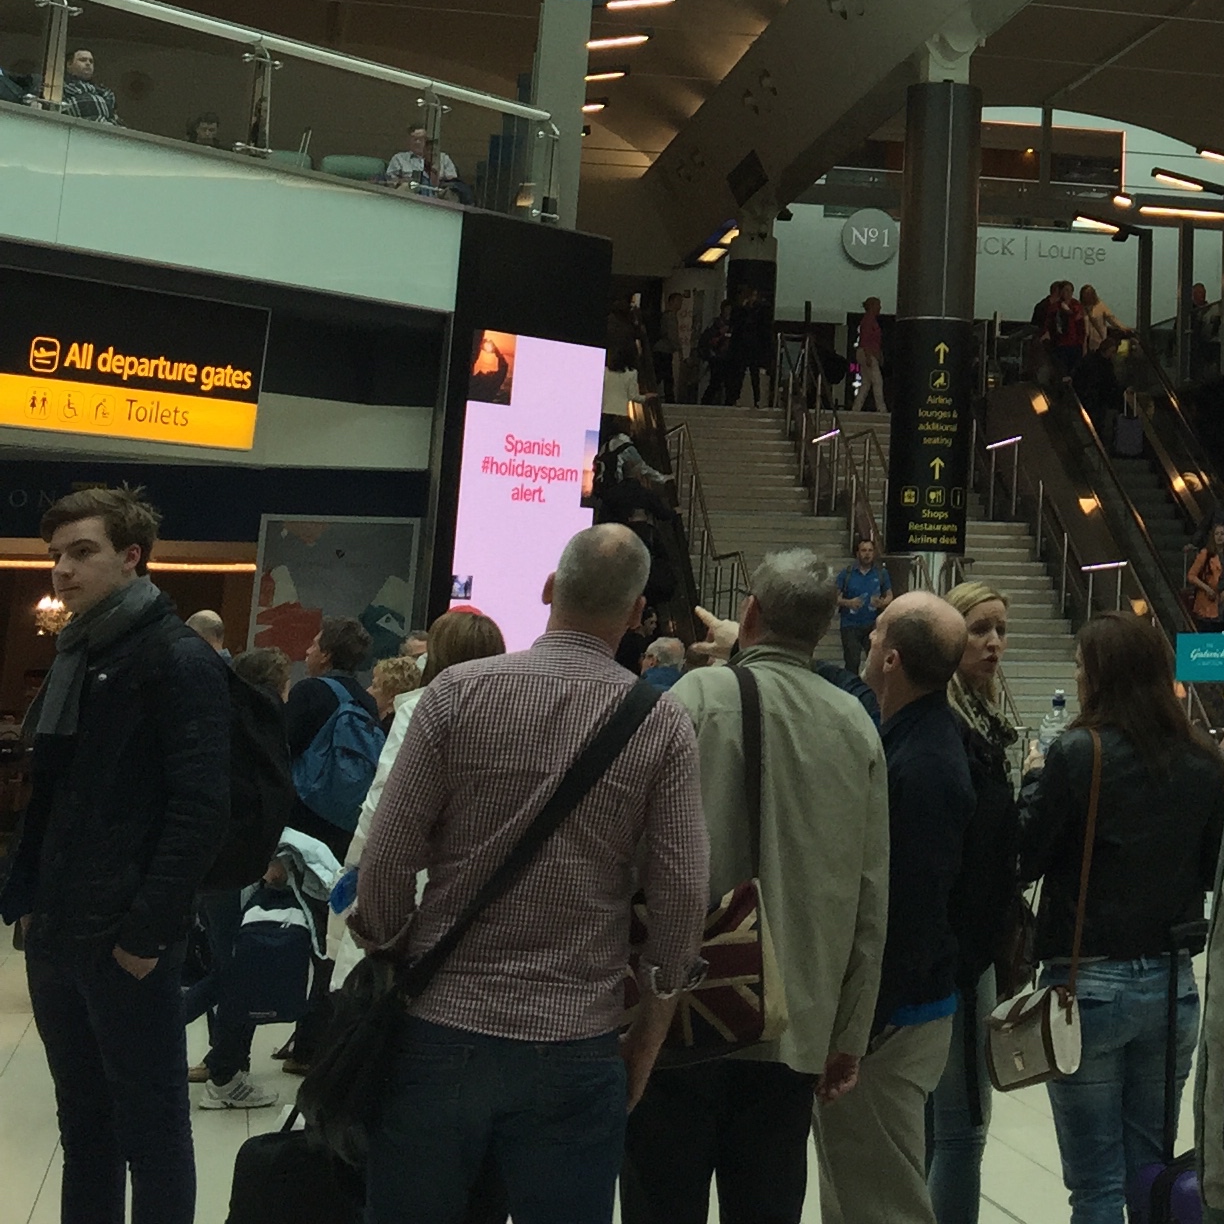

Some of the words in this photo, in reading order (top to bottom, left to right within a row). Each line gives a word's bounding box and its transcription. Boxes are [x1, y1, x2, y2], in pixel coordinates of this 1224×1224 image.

[1038, 240, 1107, 266] Lounge
[64, 342, 93, 369] All
[97, 346, 197, 380] departure
[201, 365, 252, 391] gates
[926, 395, 953, 405] Airline
[125, 398, 189, 427] Toilets
[504, 433, 561, 458] Spanish
[922, 436, 953, 447] seating
[481, 456, 579, 484] #holidayspam
[511, 483, 546, 503] alert.
[922, 509, 949, 520] Shops
[908, 522, 958, 533] Restaurants
[908, 534, 938, 545] Airline
[939, 534, 957, 545] desk
